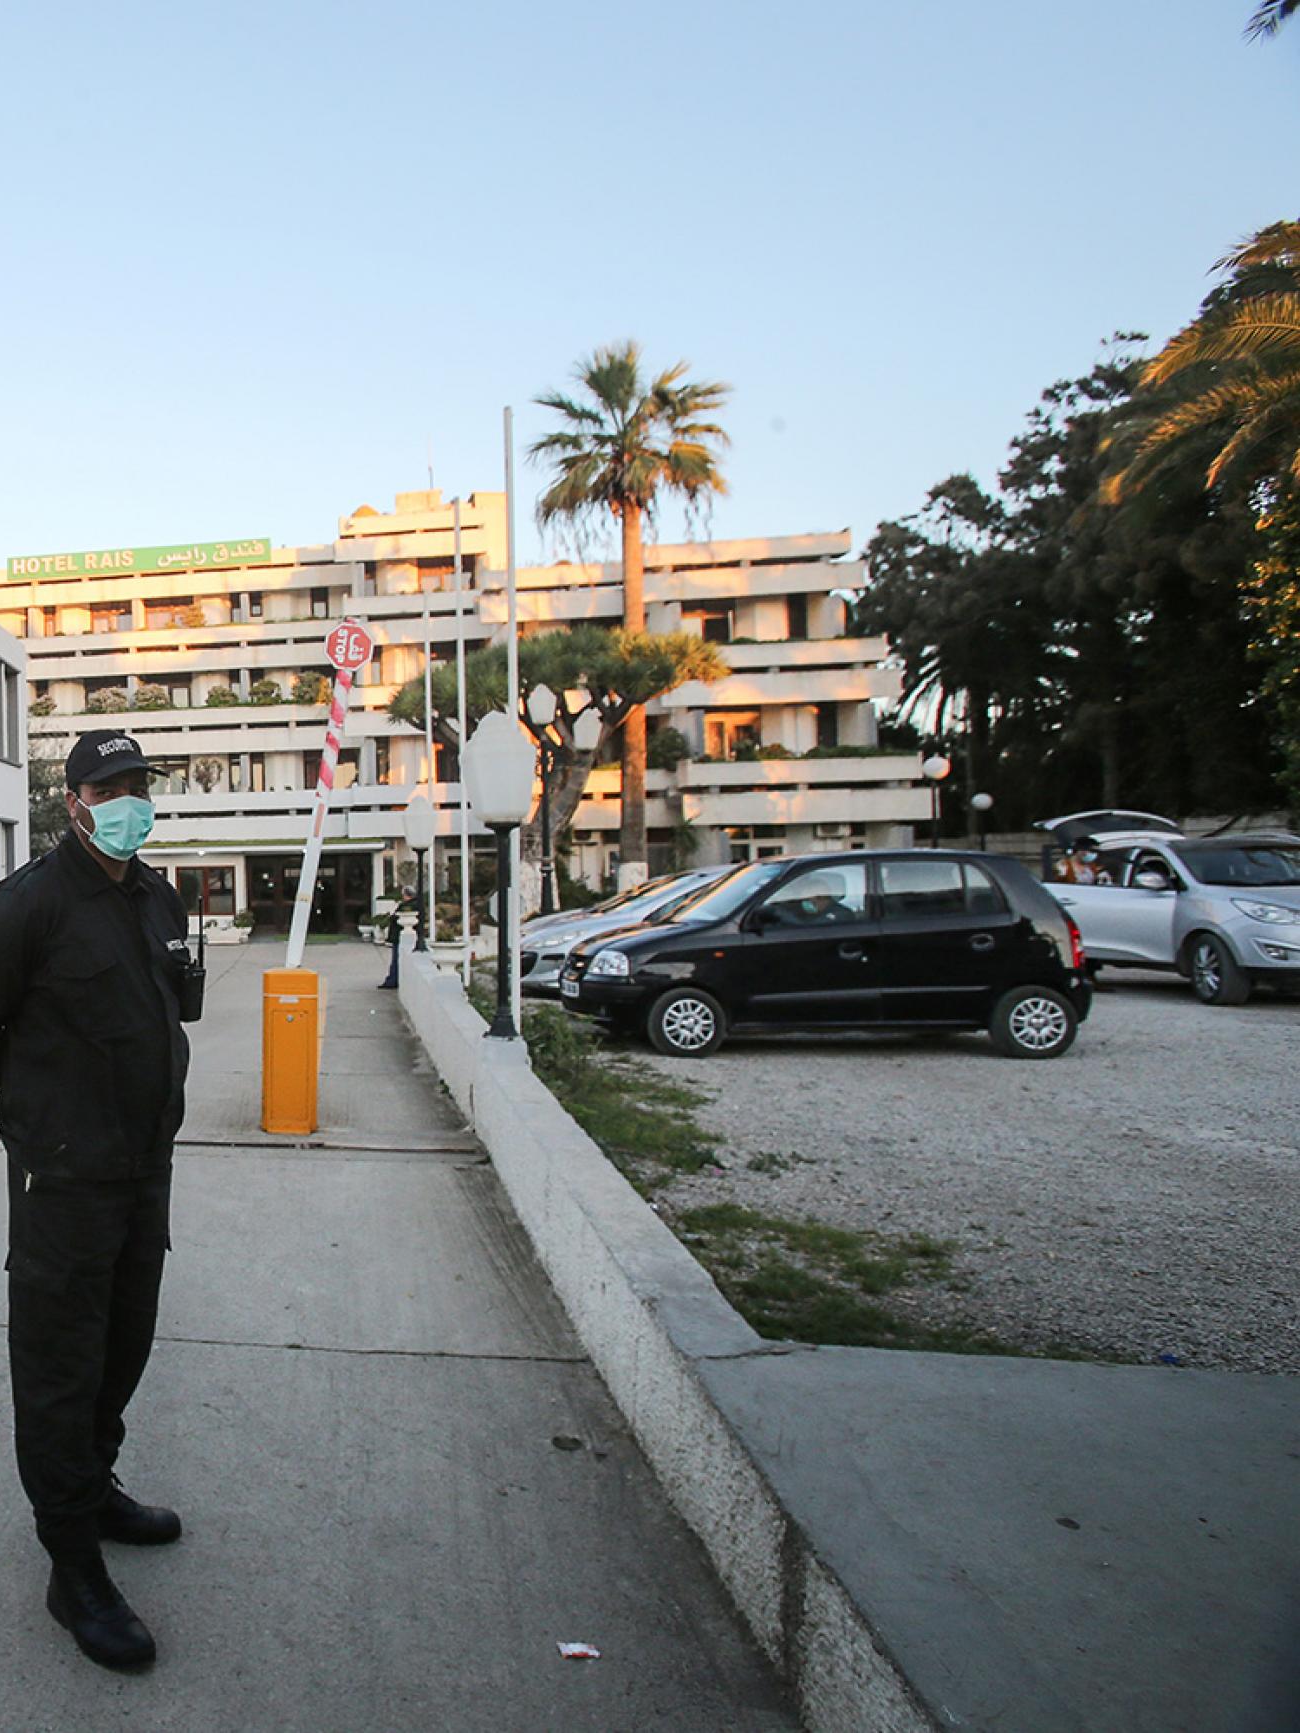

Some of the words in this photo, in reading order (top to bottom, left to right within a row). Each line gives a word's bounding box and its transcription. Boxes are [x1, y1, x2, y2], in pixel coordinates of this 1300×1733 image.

[12, 556, 78, 575] HOTEL
[85, 550, 135, 570] RAIS
[157, 546, 207, 566] رايس
[212, 540, 265, 561] فندق
[335, 629, 348, 662] STOP
[348, 633, 365, 661] قف
